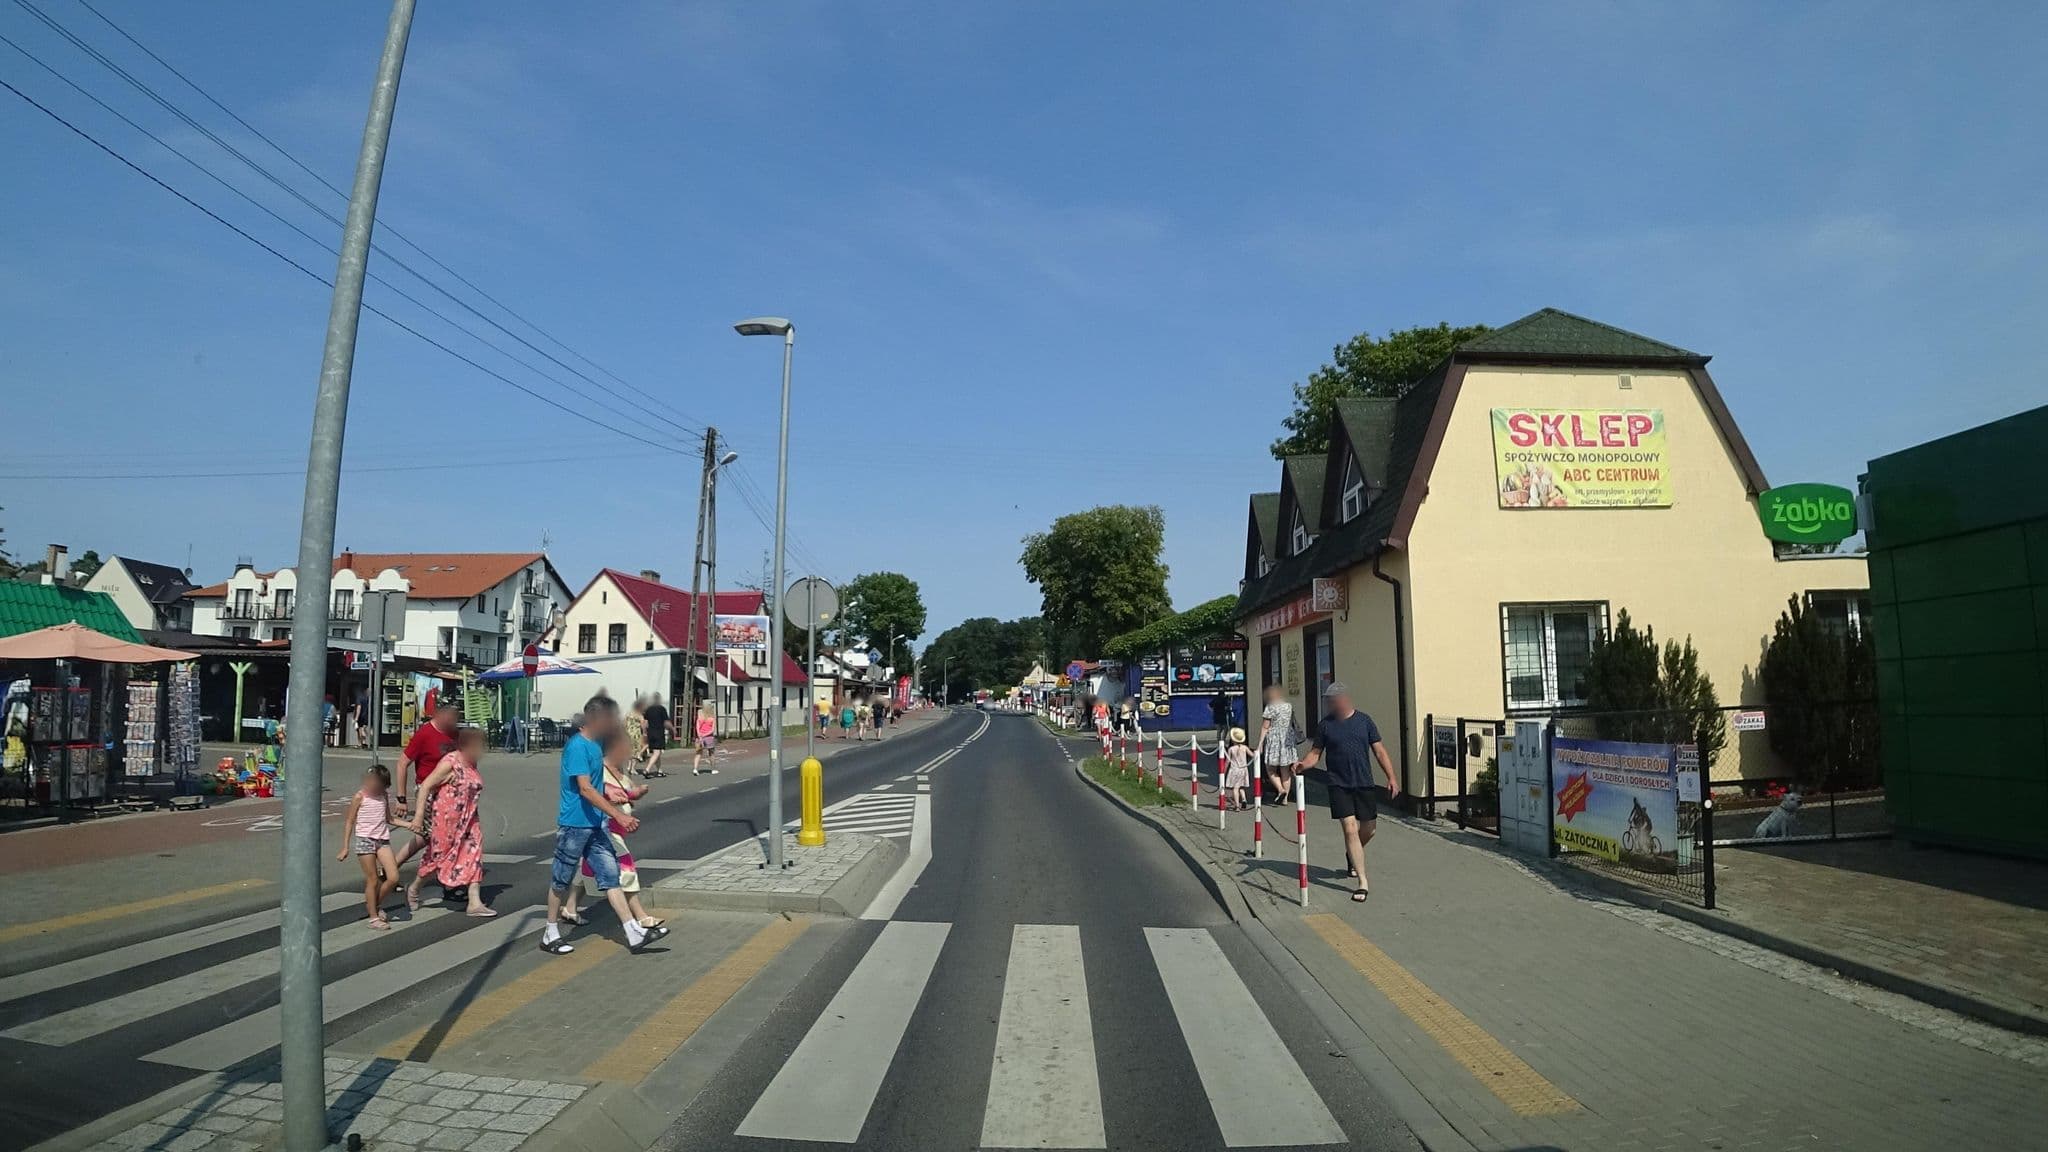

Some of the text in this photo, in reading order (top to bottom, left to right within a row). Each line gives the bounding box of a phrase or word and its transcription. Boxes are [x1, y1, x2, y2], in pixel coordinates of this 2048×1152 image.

[1507, 412, 1654, 448] SKLEP
[1505, 450, 1660, 463] SPOŻYWCZO MONOPOLOWY
[1563, 468, 1660, 482] ABC CENTRUM
[1772, 497, 1850, 522] żabka
[1743, 717, 1764, 725] ZAKAZ
[1620, 755, 1670, 773] ROWERÓW
[1592, 771, 1604, 781] DLA
[1604, 773, 1625, 784] DZIECI
[1629, 775, 1671, 789] DOROSŁYCH
[1554, 828, 1617, 855] ul. ZATOCZNA 1
